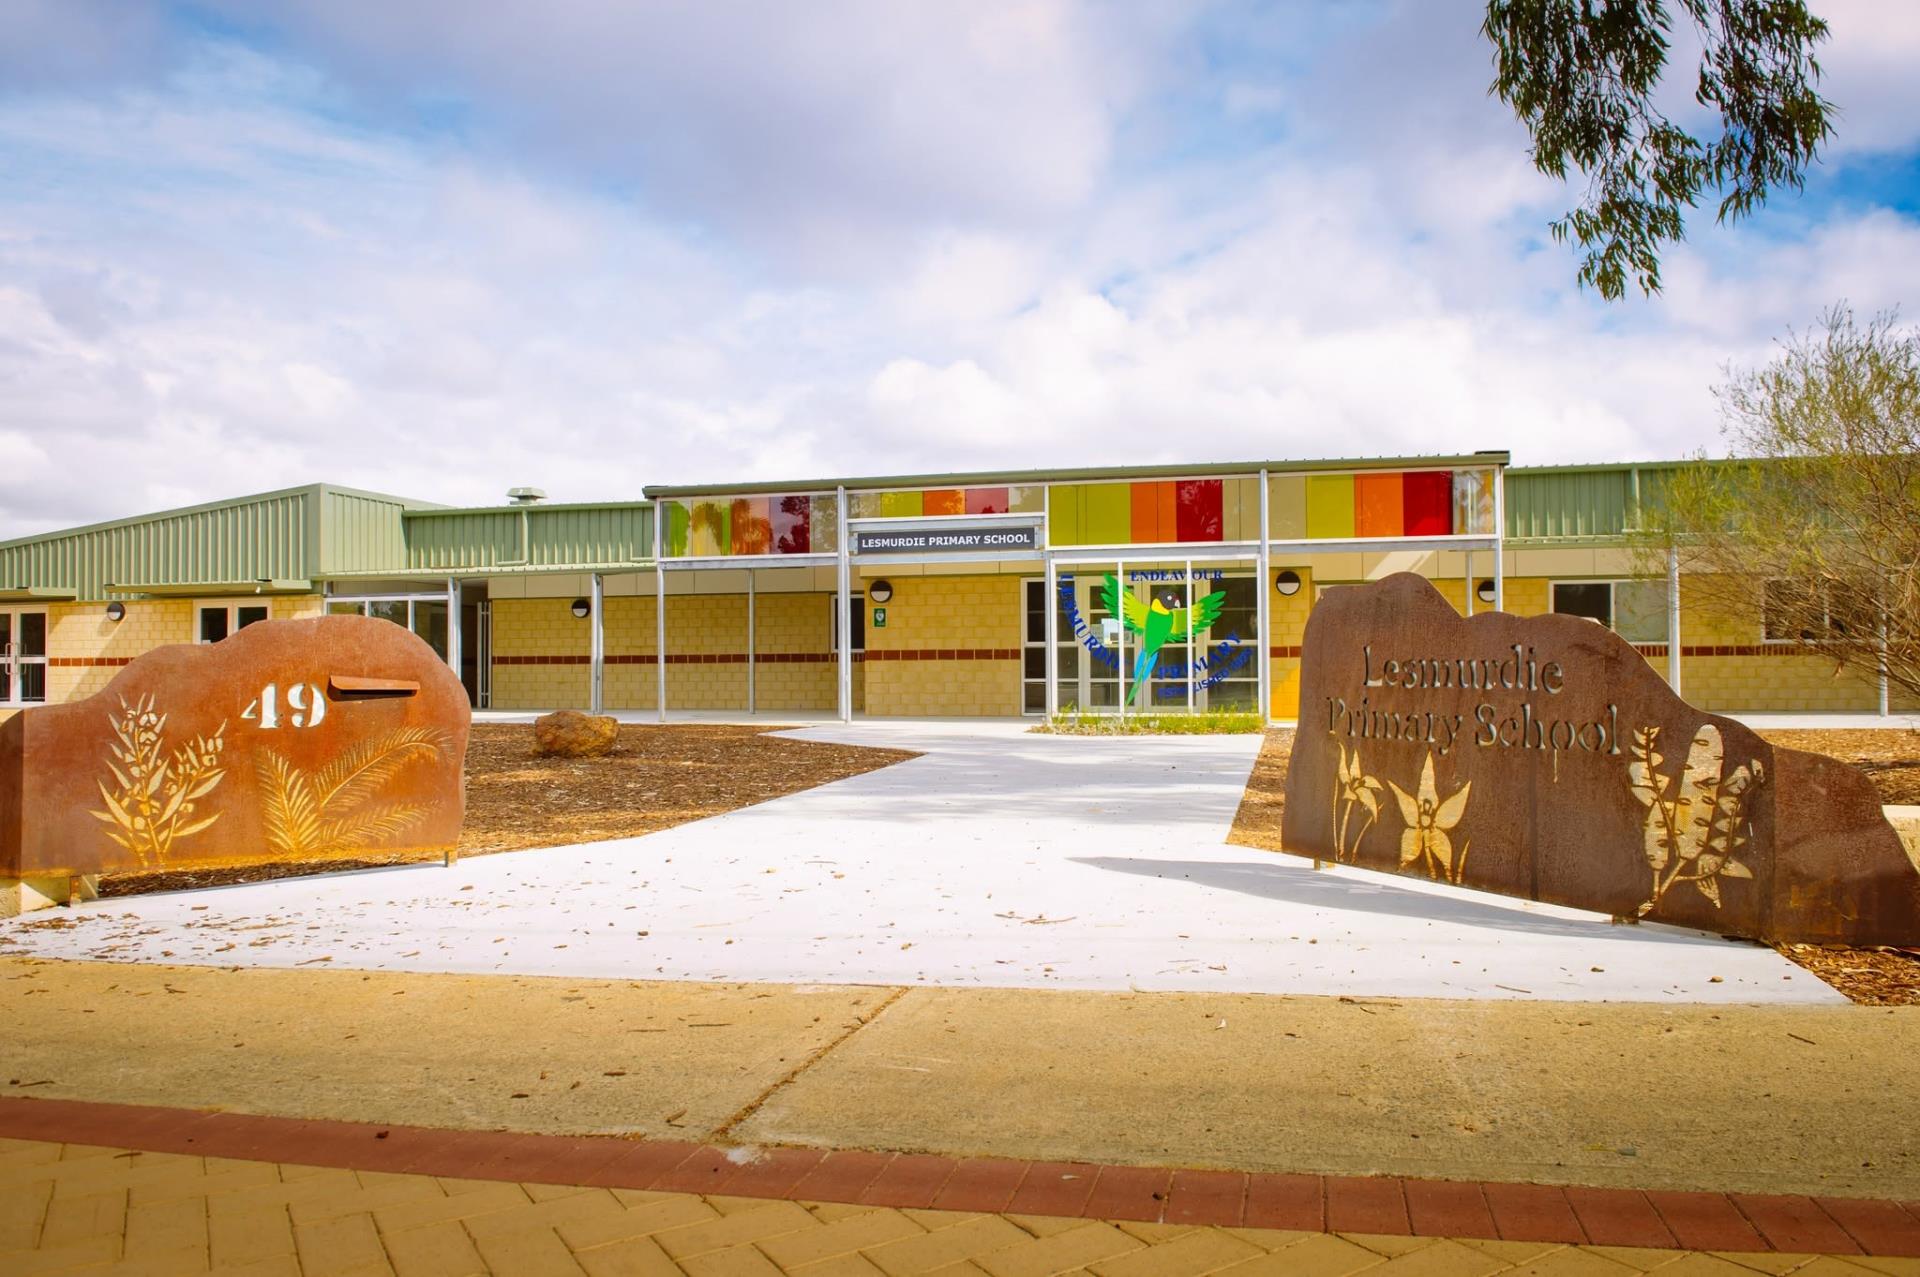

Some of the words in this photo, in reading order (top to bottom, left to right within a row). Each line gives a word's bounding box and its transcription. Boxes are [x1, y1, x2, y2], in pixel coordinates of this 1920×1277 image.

[862, 537, 926, 548] LESMURDIE
[928, 535, 982, 546] PRIMARY
[983, 533, 1031, 544] SCHOOL
[1130, 569, 1224, 582] ENDEAVOUR
[1363, 644, 1565, 694] Lesmurdie
[240, 682, 326, 728] 49
[1326, 696, 1463, 755] Primary
[1475, 703, 1621, 755] School
